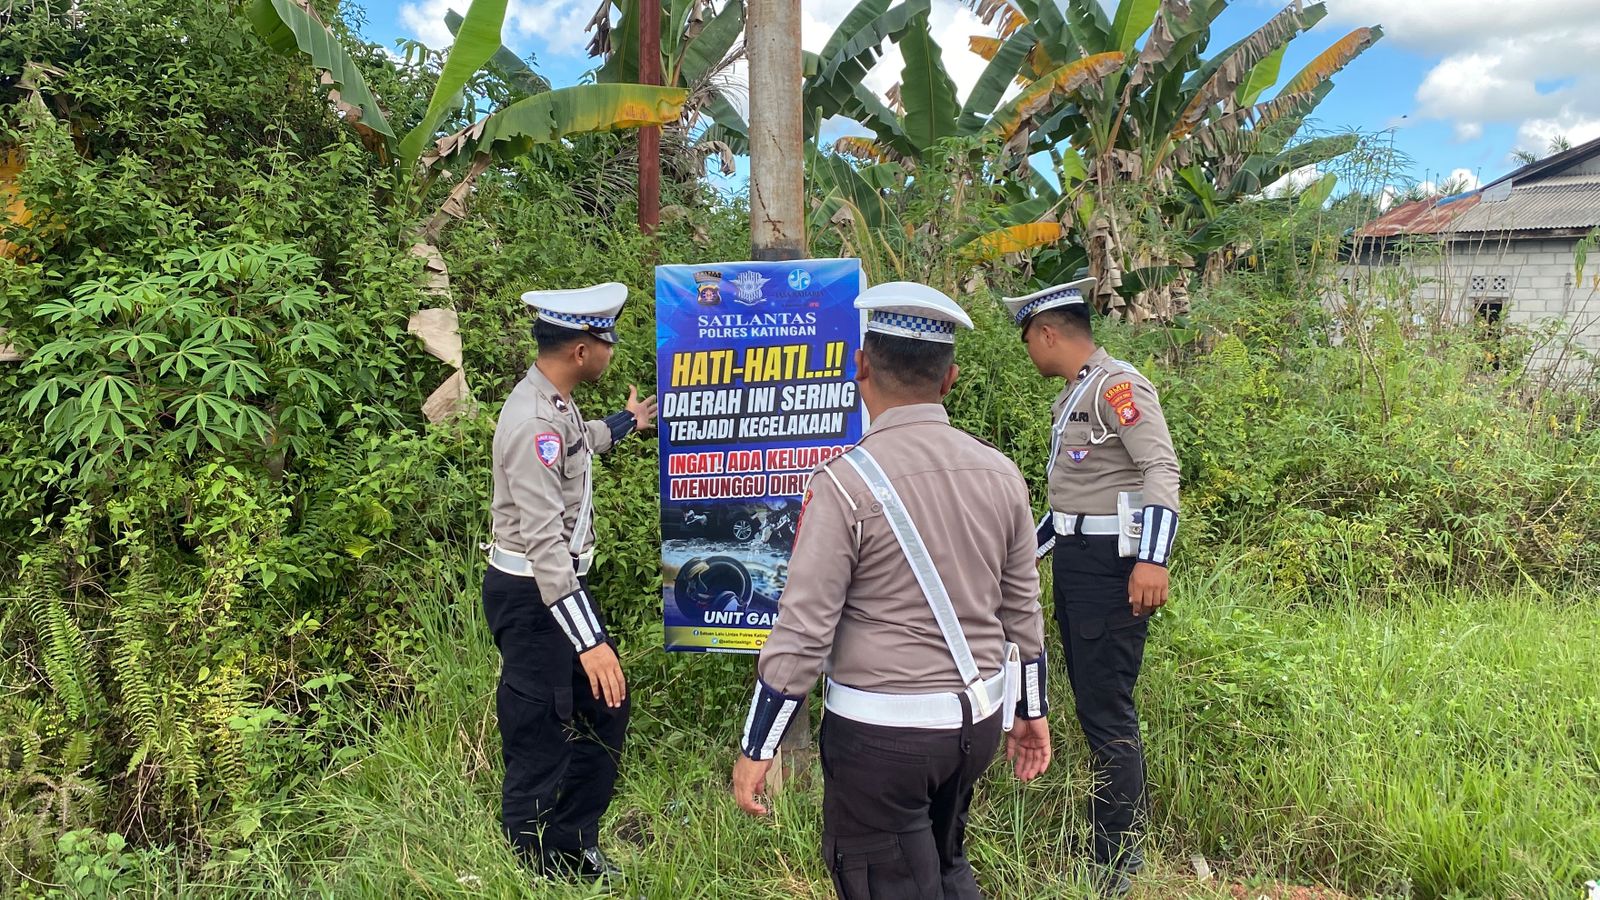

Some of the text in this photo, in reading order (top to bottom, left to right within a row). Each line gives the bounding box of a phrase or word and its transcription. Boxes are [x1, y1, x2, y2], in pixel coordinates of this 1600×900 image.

[698, 312, 816, 327] SATLANTAS
[699, 325, 816, 338] POLRES KATINGAN
[671, 341, 845, 387] HATI-HATI..!!
[662, 381, 856, 418] DAERAH INI SERING
[669, 412, 843, 442] TERJADI KECELAKAAN
[668, 451, 723, 475] INGAT!
[727, 449, 763, 473] ADA
[670, 475, 766, 499] MENUNGGU
[703, 611, 744, 625] UNIT
